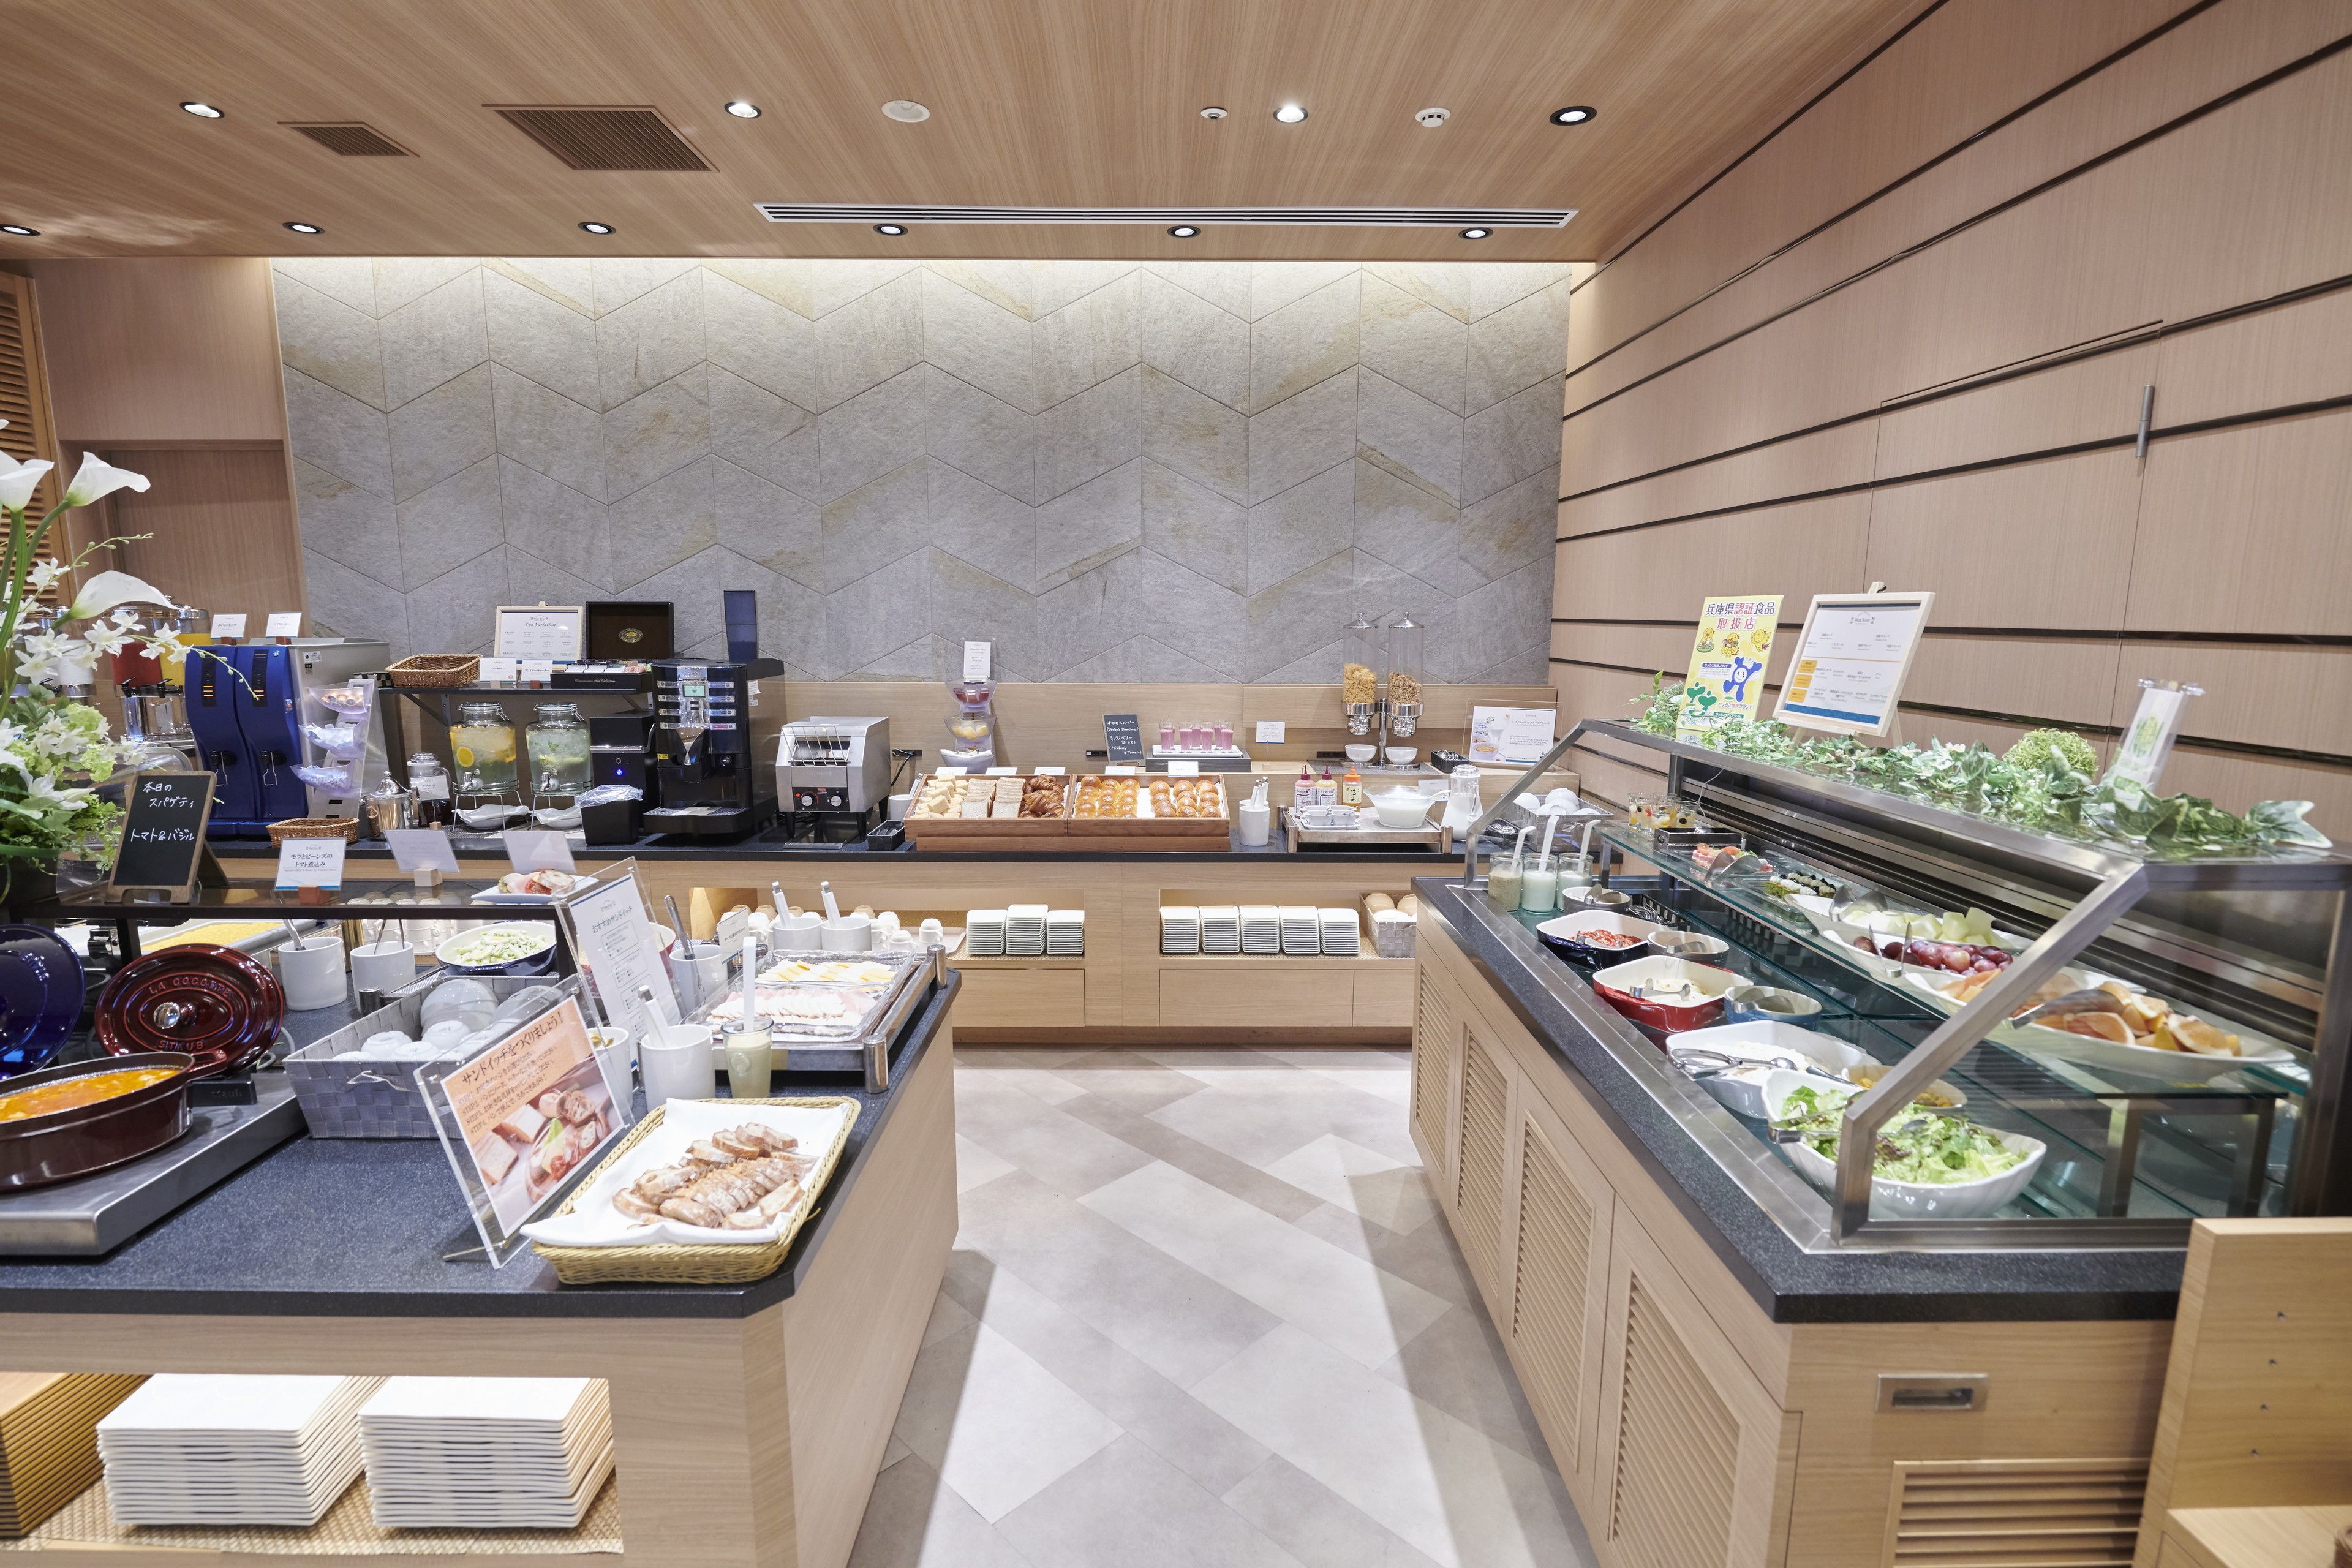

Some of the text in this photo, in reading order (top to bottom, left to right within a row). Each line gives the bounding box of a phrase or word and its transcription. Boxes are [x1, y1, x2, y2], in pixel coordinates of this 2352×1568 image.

[1706, 601, 1776, 616] 兵庫県認証食品
[1717, 617, 1756, 630] 取扱店
[142, 781, 172, 793] 本日の
[149, 796, 194, 808] スパゲティ
[149, 976, 233, 997] LA COCOTTE
[158, 1039, 205, 1051] STAUB
